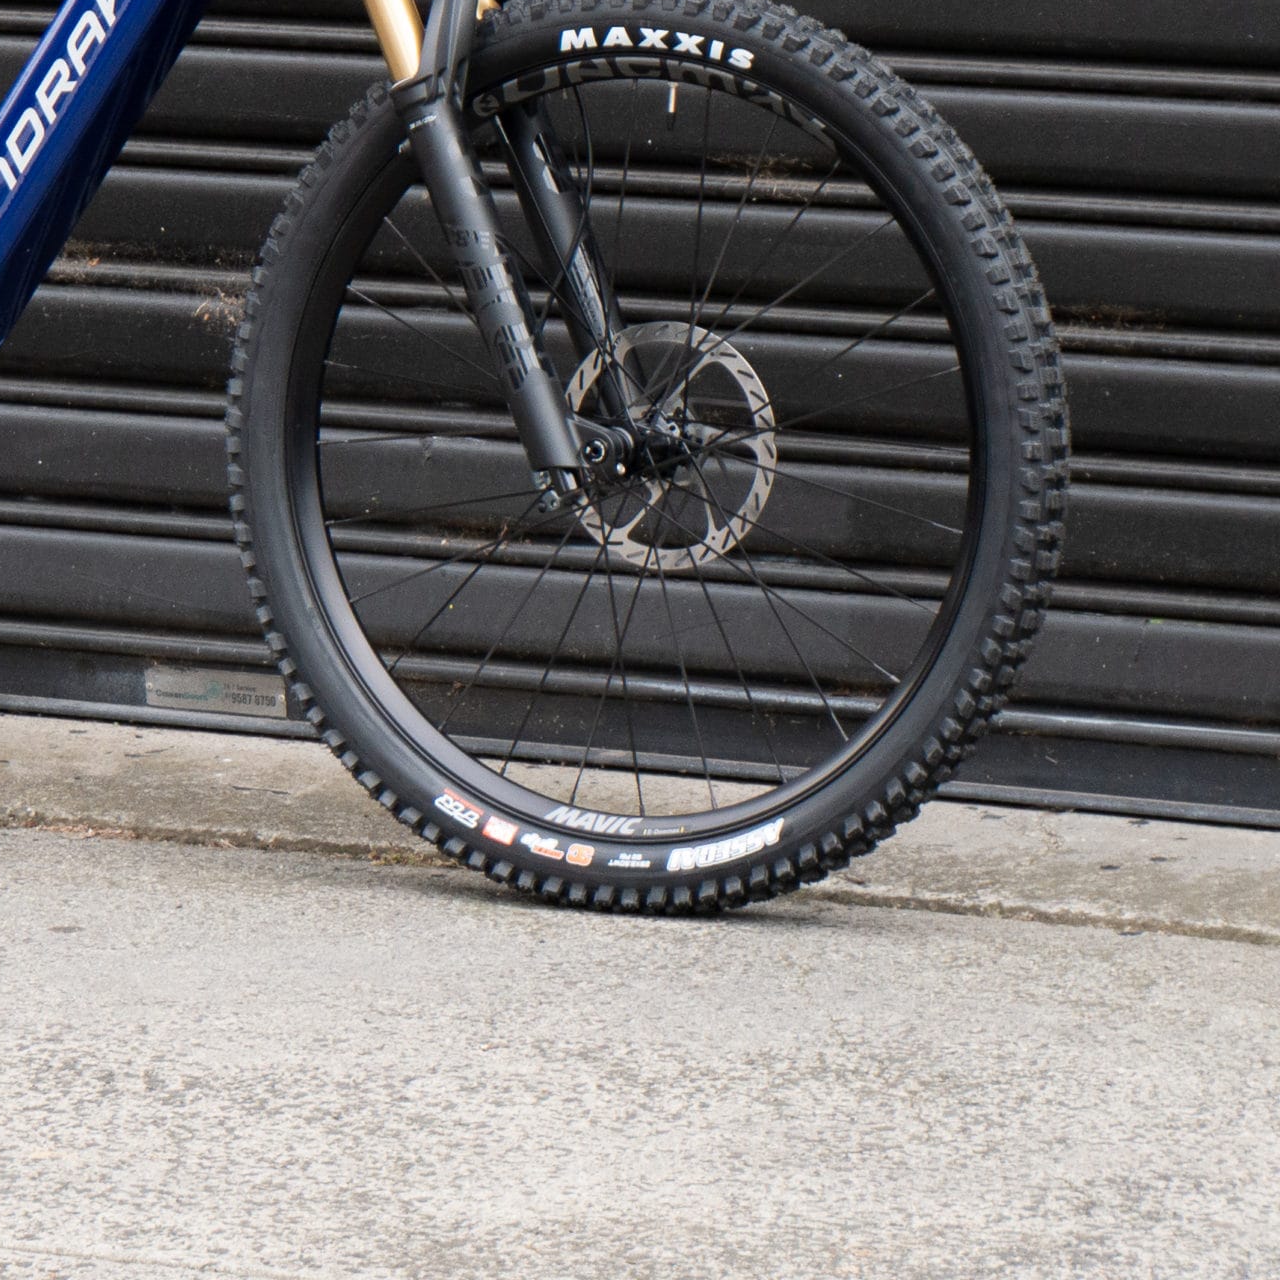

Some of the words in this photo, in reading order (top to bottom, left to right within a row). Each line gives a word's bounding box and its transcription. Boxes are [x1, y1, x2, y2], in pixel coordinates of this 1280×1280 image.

[560, 26, 755, 70] MAXXIS
[544, 805, 644, 836] MAVIC
[666, 817, 785, 871] ASSEGAI
